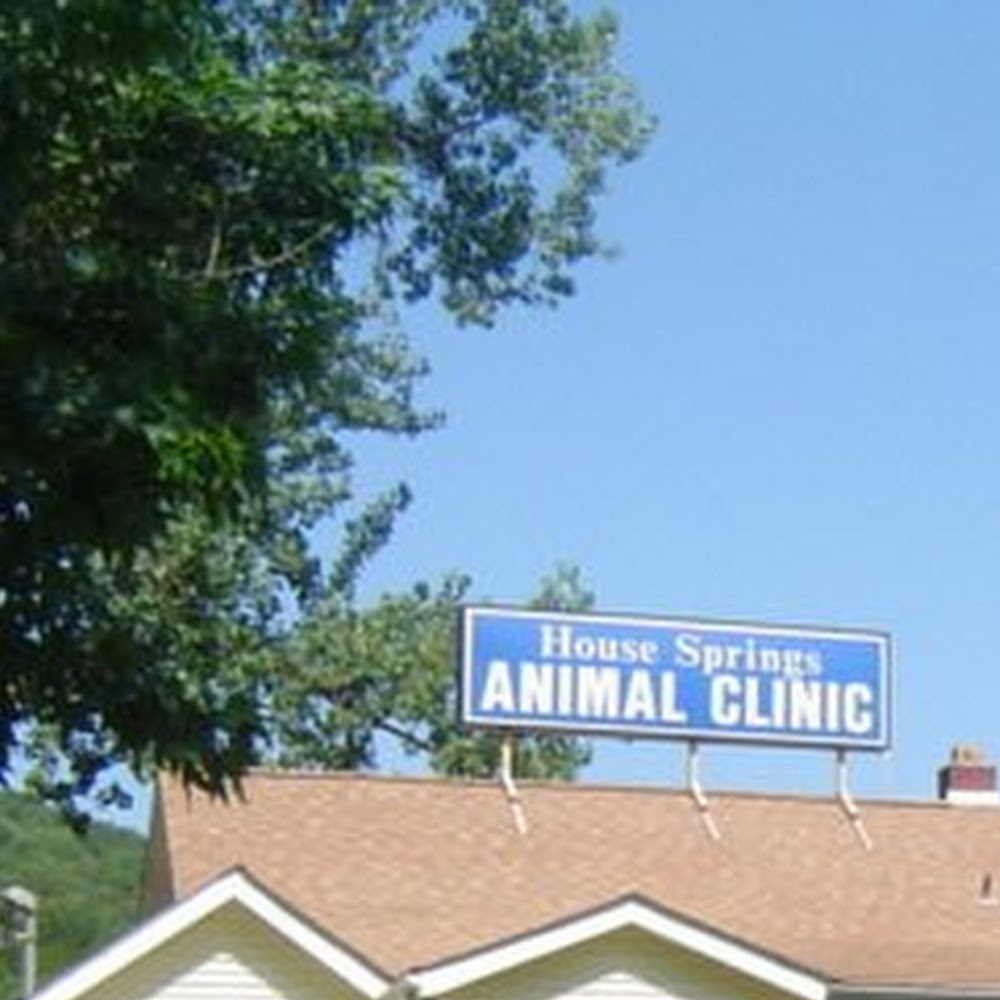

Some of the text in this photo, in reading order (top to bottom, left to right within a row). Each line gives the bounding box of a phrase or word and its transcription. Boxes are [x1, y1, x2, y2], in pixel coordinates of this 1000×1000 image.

[540, 625, 823, 676] House Springs
[481, 660, 872, 733] ANIMAL CLINIC
